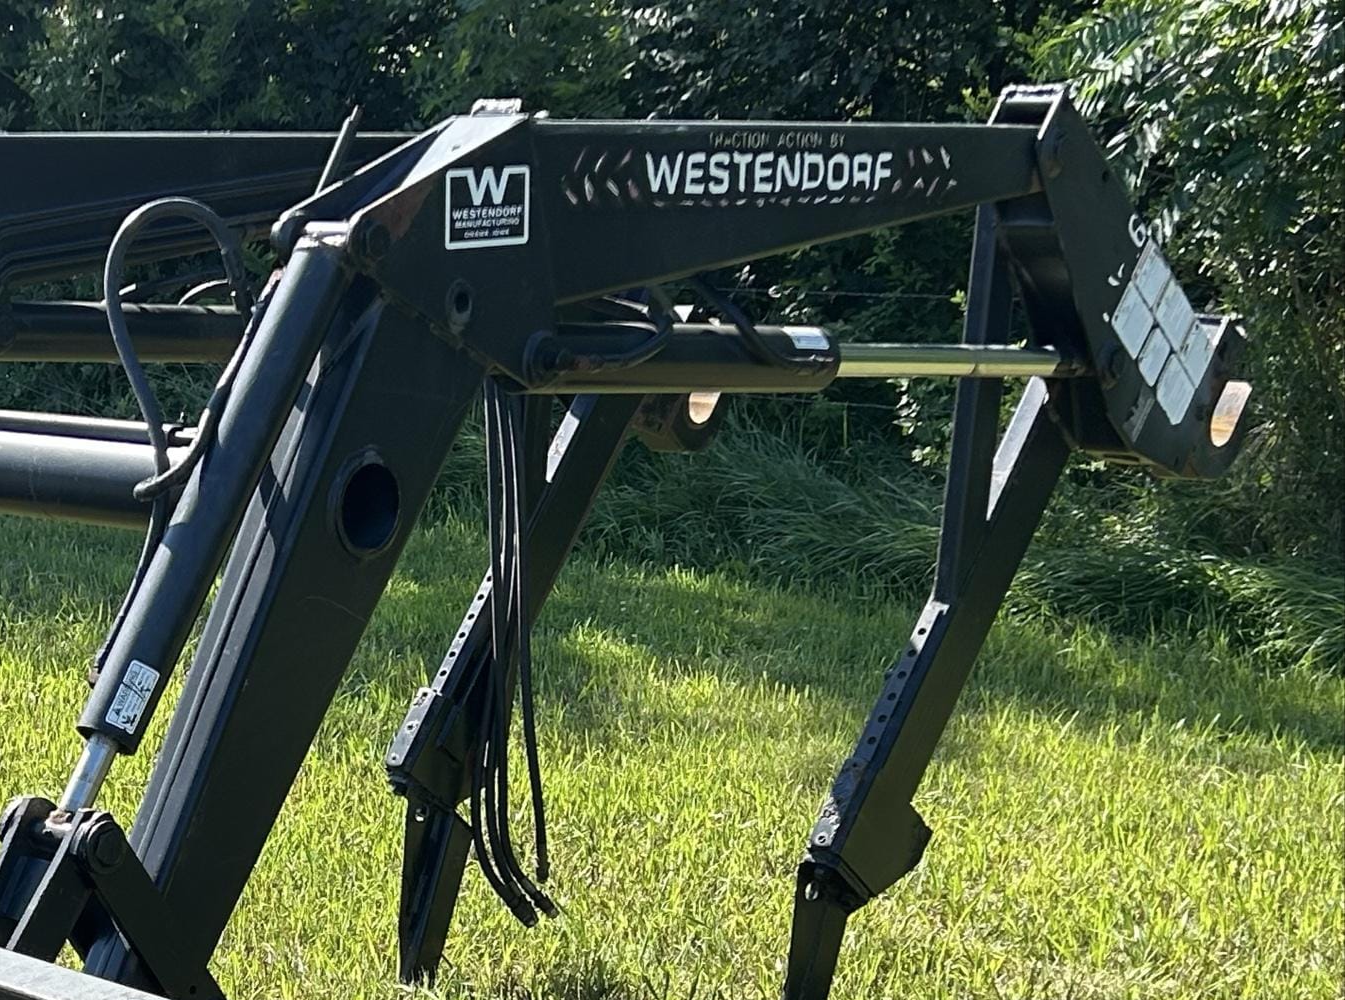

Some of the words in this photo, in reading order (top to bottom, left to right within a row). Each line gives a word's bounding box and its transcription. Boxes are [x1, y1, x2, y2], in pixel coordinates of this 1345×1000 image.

[777, 131, 822, 149] ACTION
[830, 131, 846, 149] BY
[467, 166, 509, 206] W
[645, 151, 893, 195] WESTENDORF
[452, 206, 522, 219] WESTENDORF
